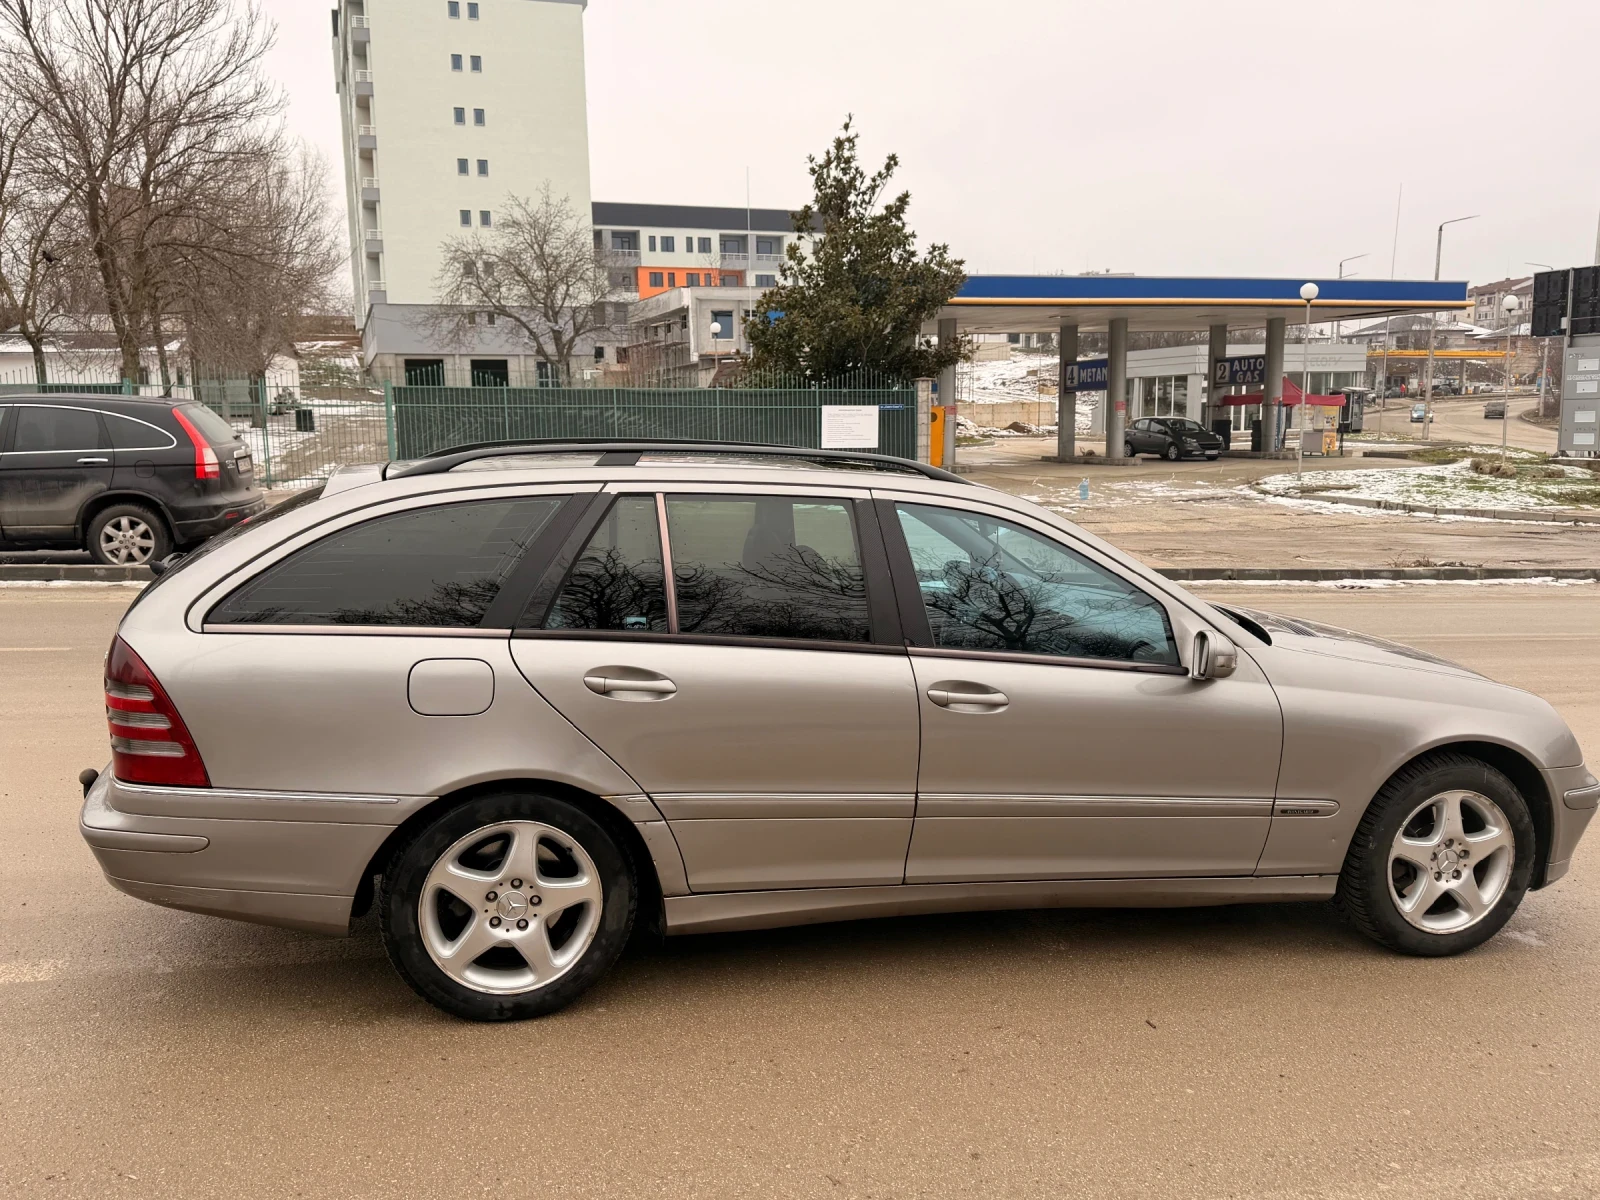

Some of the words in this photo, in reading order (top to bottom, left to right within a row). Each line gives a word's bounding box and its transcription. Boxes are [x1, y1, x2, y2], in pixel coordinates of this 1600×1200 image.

[1218, 363, 1226, 380] 2
[1232, 358, 1265, 372] AUTO
[1068, 366, 1075, 384] 4
[1079, 366, 1108, 383] METAN
[1236, 370, 1260, 383] GAS
